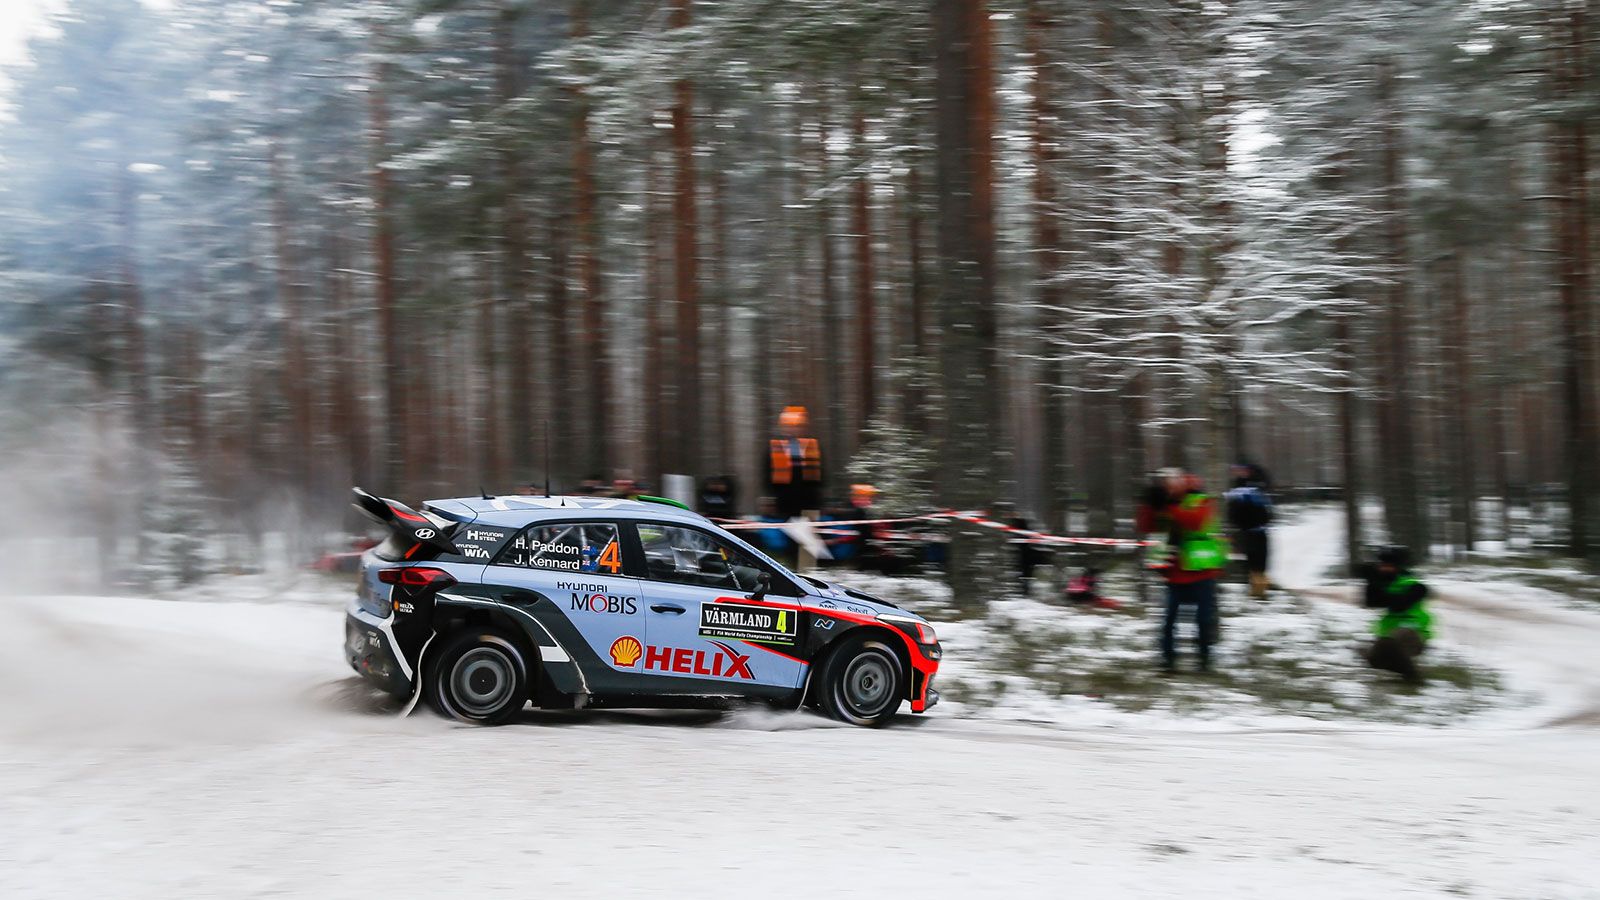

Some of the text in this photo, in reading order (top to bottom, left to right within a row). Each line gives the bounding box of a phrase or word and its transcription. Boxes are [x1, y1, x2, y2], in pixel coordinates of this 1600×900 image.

[464, 548, 490, 559] WIA
[515, 538, 579, 555] H. Paddon
[514, 554, 580, 570] J. Kennard
[599, 541, 621, 573] 4
[557, 581, 608, 593] HYUNDAI
[571, 592, 637, 614] MOBIS
[704, 607, 786, 634] VÄRMLAND 4
[746, 632, 772, 640] Championship
[644, 640, 756, 680] HELIX
